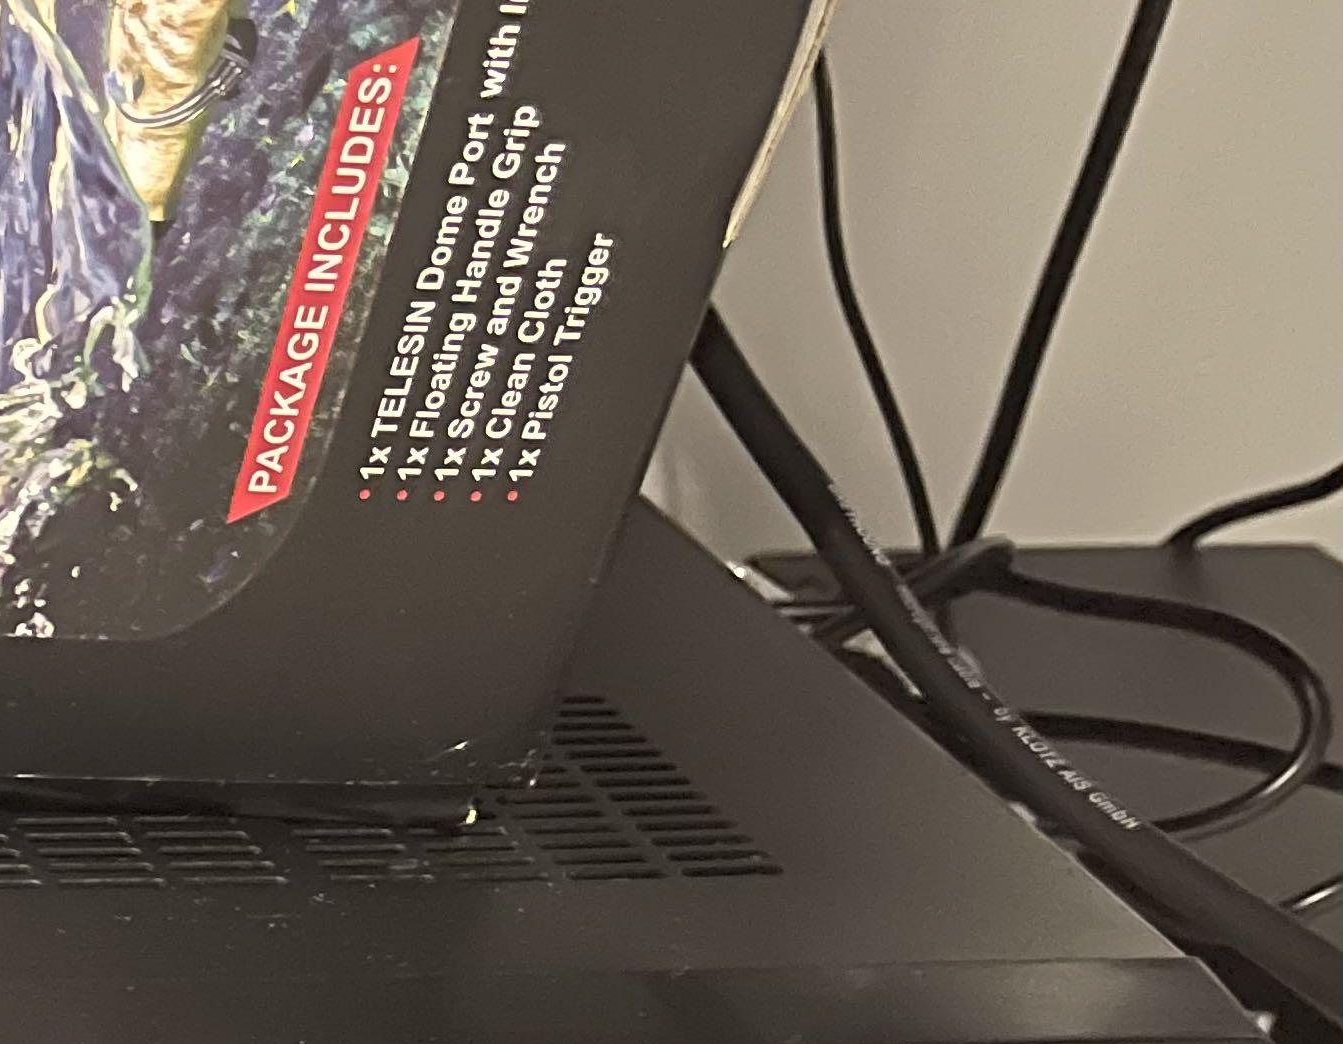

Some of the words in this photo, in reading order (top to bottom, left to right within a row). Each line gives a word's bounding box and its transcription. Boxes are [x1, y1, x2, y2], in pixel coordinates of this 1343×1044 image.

[480, 23, 521, 98] with
[448, 112, 495, 186] Port
[492, 105, 541, 179] Grip
[416, 194, 468, 290] Dome
[451, 188, 510, 302] Handle
[503, 142, 566, 268] Wrench
[247, 303, 330, 496] PACKAGE
[304, 61, 400, 294] INCLUDES:
[487, 276, 522, 336] and
[517, 257, 568, 344] Cloth
[553, 232, 614, 347] Trigger
[371, 301, 436, 438] TELESIN
[409, 312, 477, 438] Floating
[447, 343, 499, 439] Screw
[485, 352, 536, 440] Clean
[521, 354, 573, 441] Pistol
[359, 446, 392, 480] 1x
[397, 446, 429, 480] 1x
[434, 447, 467, 481] 1x
[471, 447, 504, 482] 1x
[508, 448, 541, 482] 1x
[1089, 791, 1143, 830] GmbH
